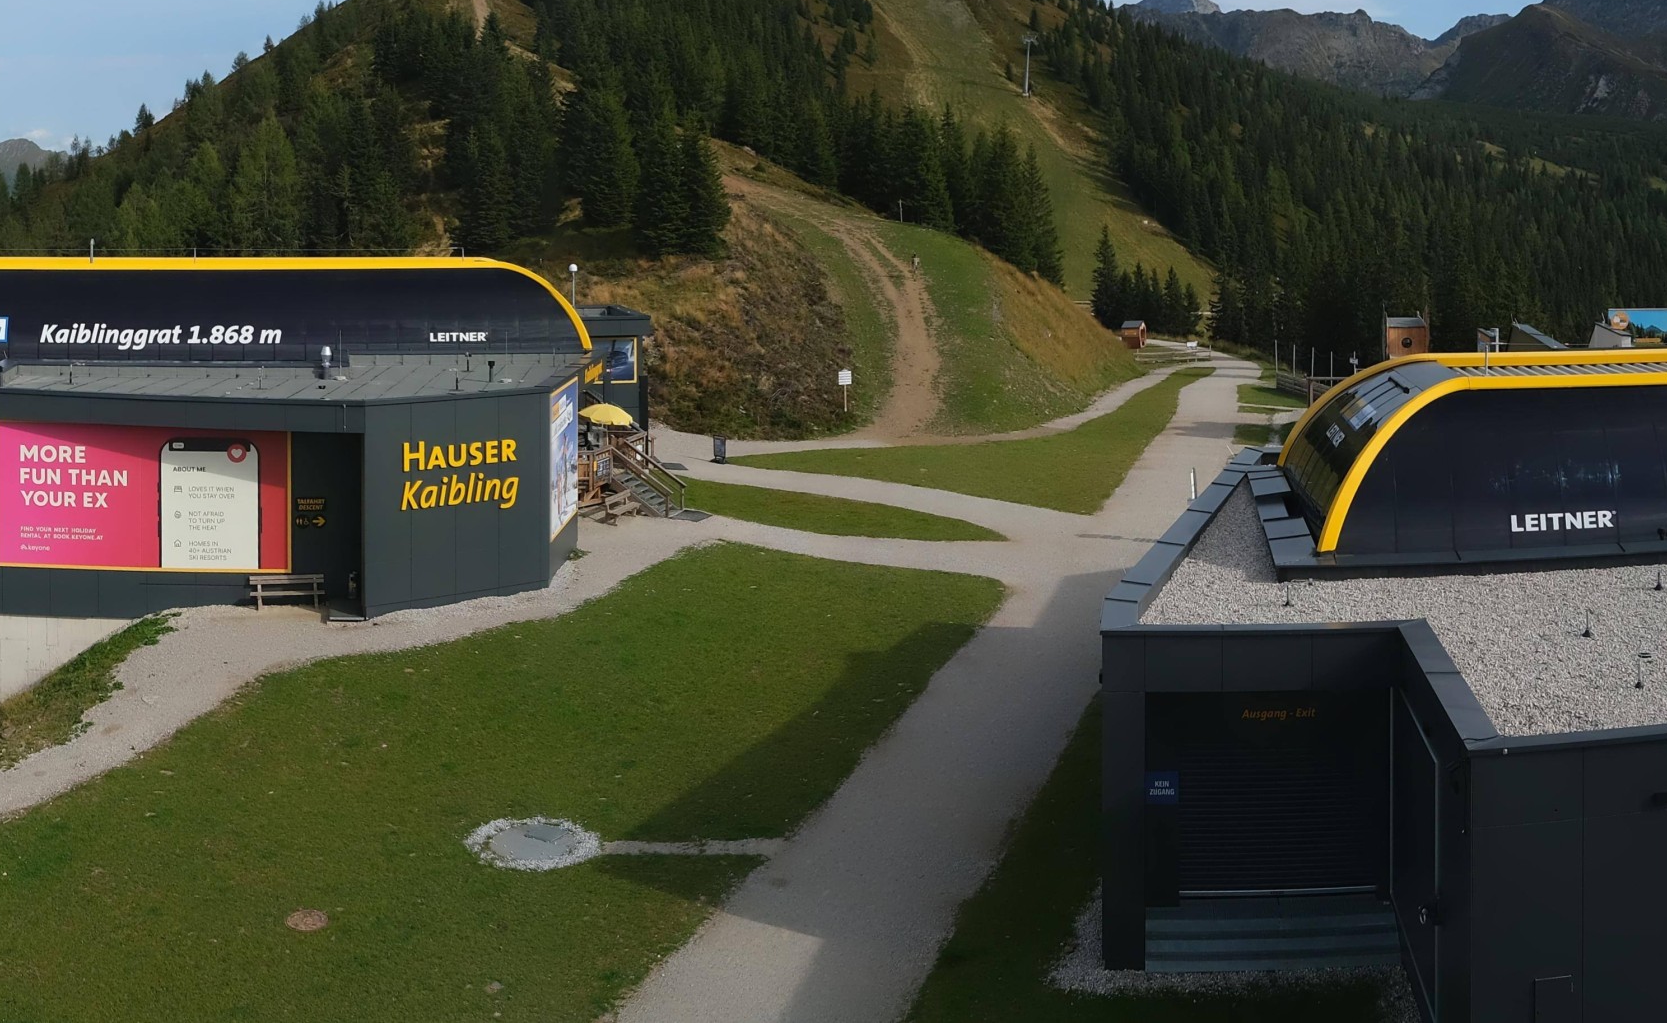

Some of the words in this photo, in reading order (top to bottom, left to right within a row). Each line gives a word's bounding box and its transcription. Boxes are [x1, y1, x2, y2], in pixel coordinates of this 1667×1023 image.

[39, 323, 182, 350] Kaiblinggrat
[187, 325, 254, 344] 1.868
[259, 328, 282, 344] m
[429, 332, 486, 342] LEITNER
[19, 444, 86, 464] MORE
[402, 438, 517, 473] HAUSER
[19, 468, 61, 485] FUN
[68, 469, 128, 487] THAN
[20, 490, 77, 507] YOUR
[83, 492, 109, 508] EX
[400, 472, 519, 511] Kaibling
[1510, 510, 1614, 532] LEITNER
[1241, 708, 1287, 721] Ausgang
[1295, 707, 1316, 718] Exit
[1149, 788, 1175, 796] ZUGANG
[1154, 780, 1170, 788] KEIN
